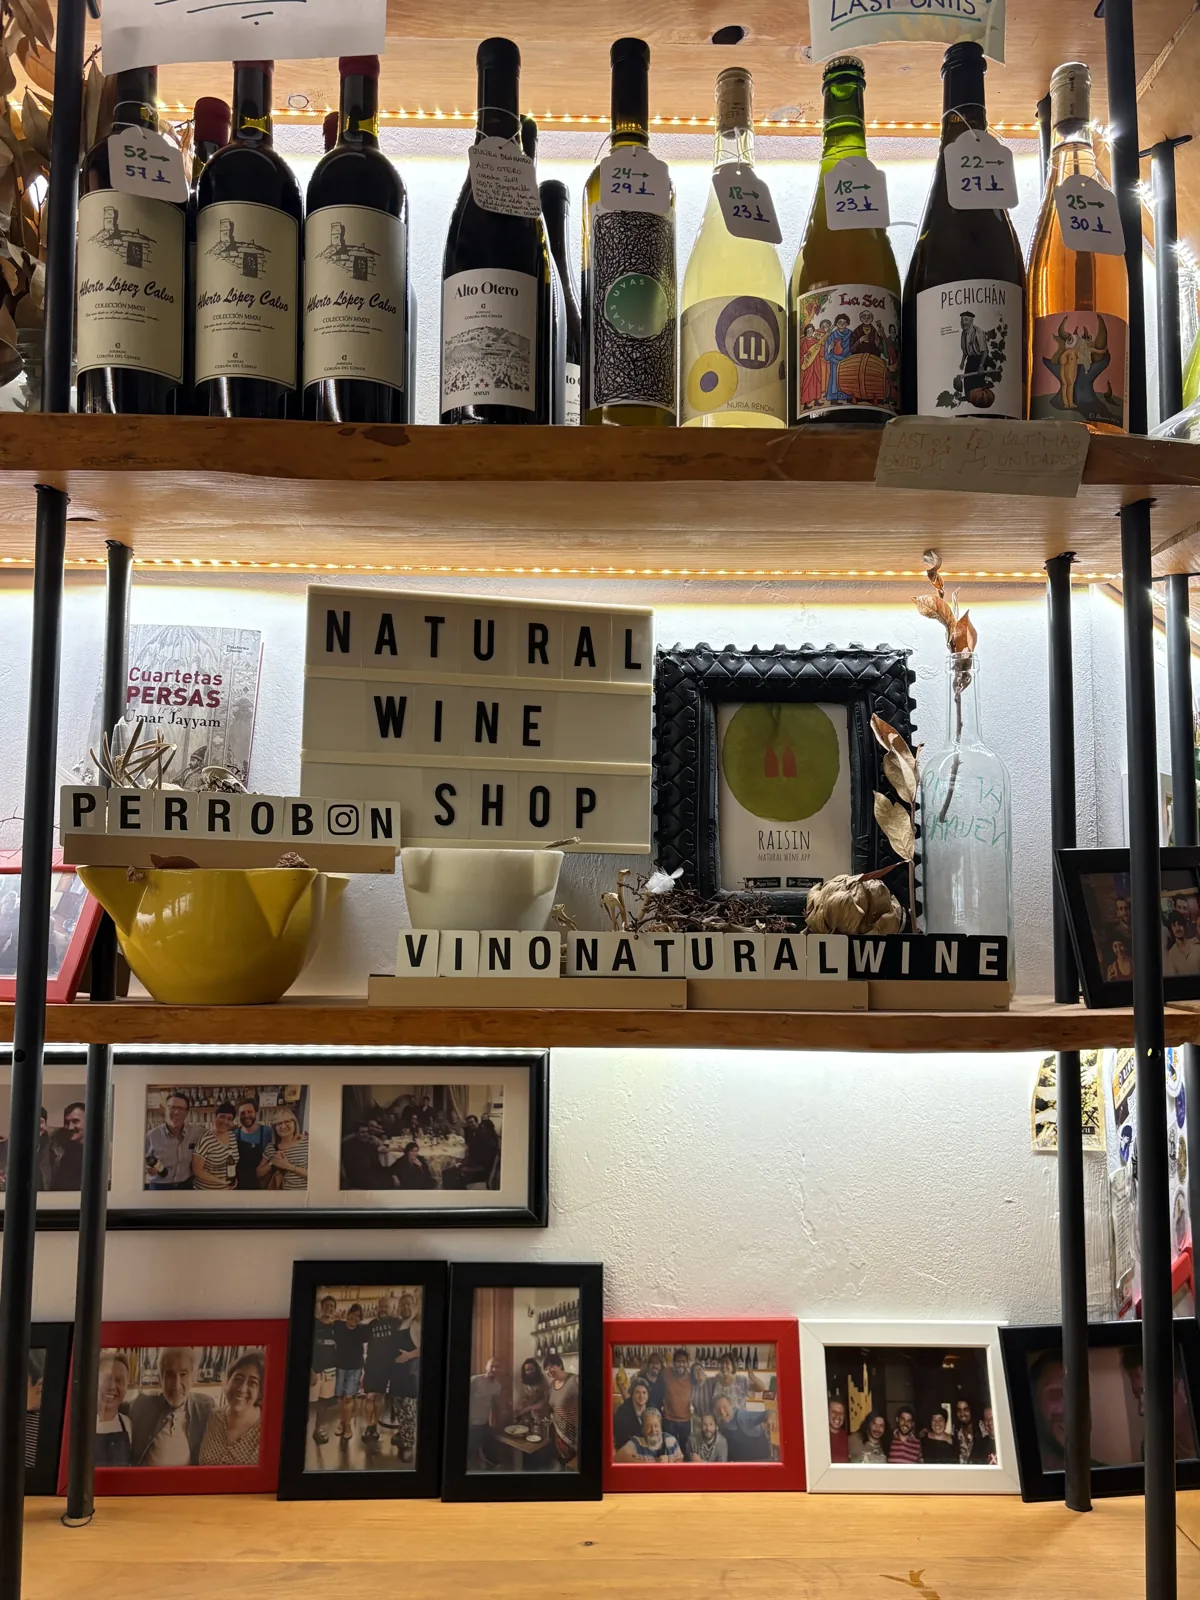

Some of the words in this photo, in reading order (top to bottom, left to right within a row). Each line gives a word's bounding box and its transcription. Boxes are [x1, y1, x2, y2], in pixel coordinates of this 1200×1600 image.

[124, 144, 148, 161] 52
[476, 161, 495, 171] ALTO
[496, 166, 522, 175] OTERO
[960, 156, 984, 169] 22
[125, 164, 147, 179] 57
[612, 167, 632, 180] 24
[610, 182, 632, 194] 29
[834, 180, 853, 195] 18
[960, 176, 982, 192] 27
[728, 186, 743, 200] 18
[836, 198, 858, 212] 23
[1066, 194, 1088, 210] 25
[732, 205, 752, 219] 23
[1070, 216, 1090, 231] 30
[105, 276, 140, 298] López
[144, 281, 175, 303] Calvo
[454, 283, 479, 300] Alto
[480, 281, 519, 297] Otero
[612, 278, 645, 297] UVAS
[222, 287, 256, 308] López
[259, 290, 289, 312] Calvo
[306, 293, 332, 315] Alberto
[332, 290, 366, 311] López
[368, 293, 397, 314] Calvo
[838, 292, 860, 307] La
[861, 294, 886, 310] Sed
[940, 283, 1006, 310] PECHICHÁN
[94, 302, 127, 310] COLECCIÓN
[212, 312, 244, 321] COLECCIÓN
[322, 315, 353, 323] COLECCIÓN
[726, 401, 750, 409] NURIA
[751, 402, 775, 412] RENOM
[885, 432, 930, 448] LAST
[325, 609, 642, 670] NATURAL
[129, 666, 223, 686] Cuartetas
[126, 685, 221, 709] PERSAS
[168, 711, 221, 730] Jayyam
[373, 695, 543, 747] WINE
[434, 782, 597, 829] SHOP
[758, 830, 810, 850] RAISIN
[757, 853, 782, 862] NATURAL
[784, 853, 799, 862] WINE
[800, 853, 811, 861] APP
[404, 934, 551, 971] VINO
[576, 937, 839, 974] NATURAL
[852, 940, 999, 975] WINE
